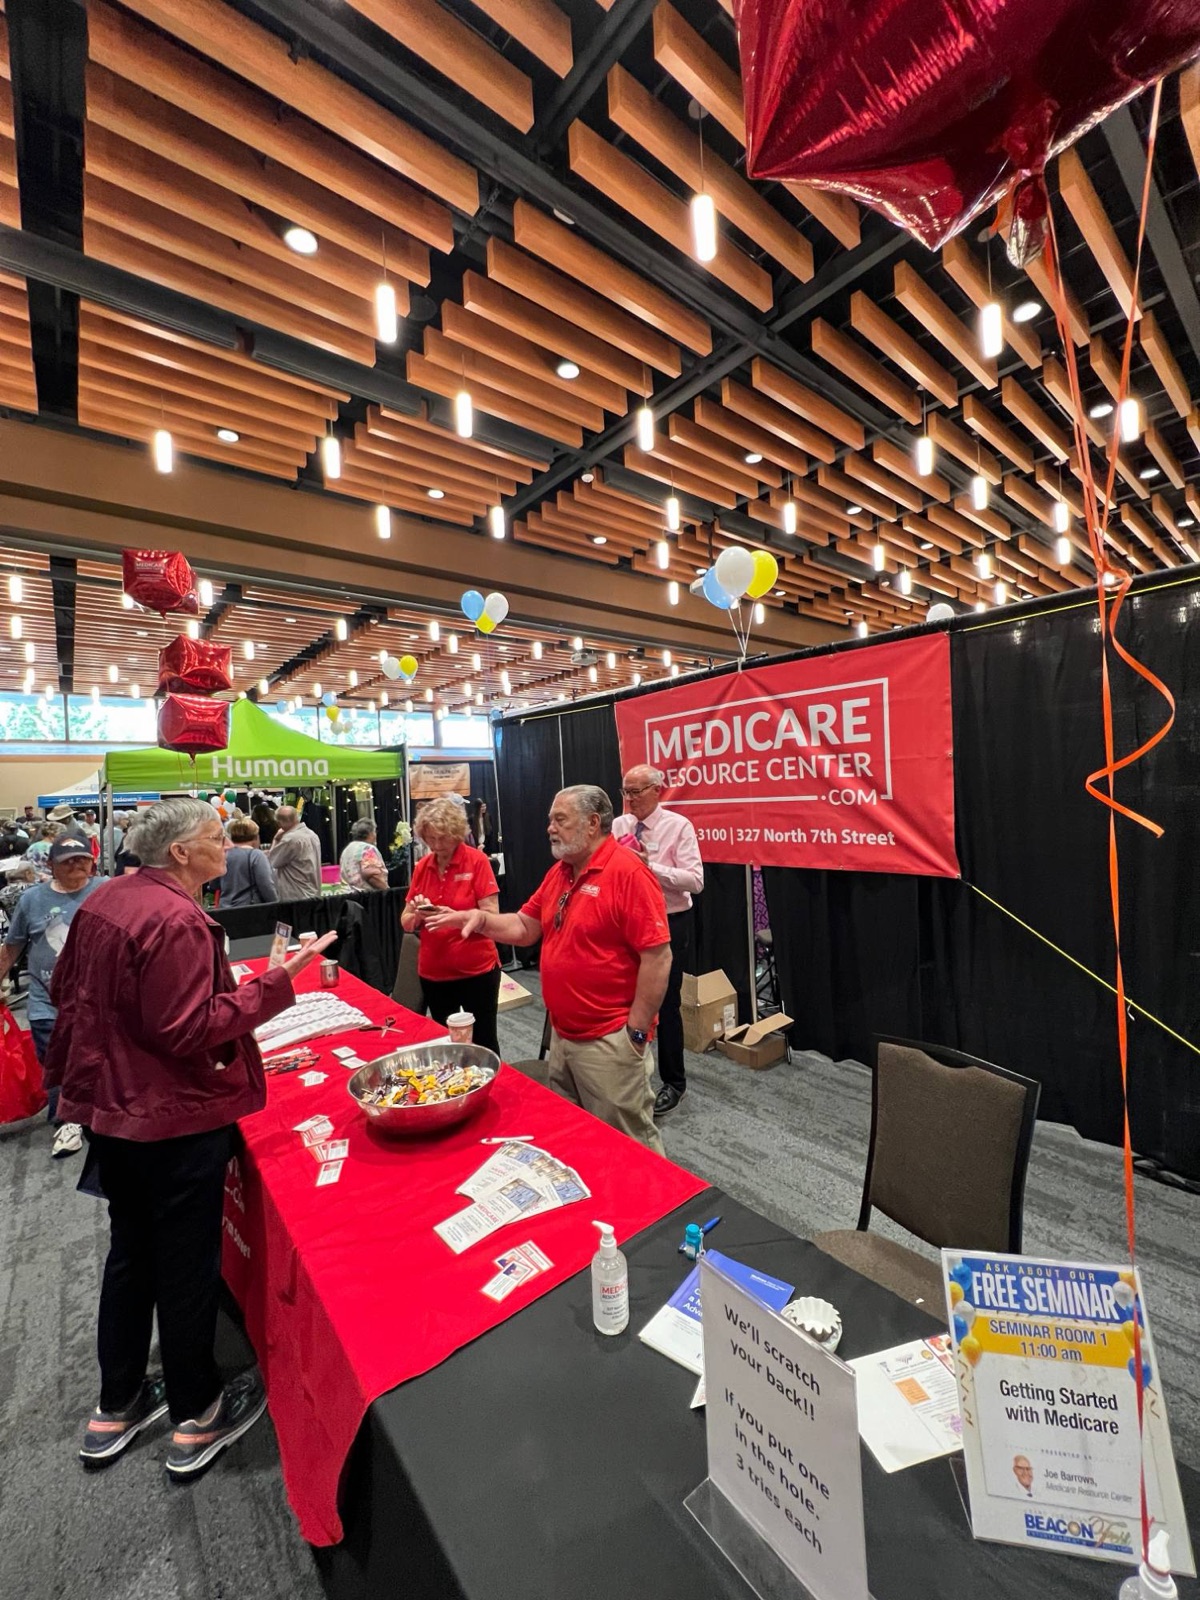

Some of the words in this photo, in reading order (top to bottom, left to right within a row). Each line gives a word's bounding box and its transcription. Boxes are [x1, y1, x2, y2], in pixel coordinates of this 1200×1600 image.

[653, 697, 871, 763] MEDICARE
[212, 755, 329, 778] Humana
[657, 761, 760, 788] RESOURCE
[766, 752, 874, 781] CENTER
[821, 789, 877, 806] .COM
[737, 829, 760, 842] 327
[764, 826, 807, 843] North
[810, 827, 837, 844] 7th
[841, 829, 896, 846] Street
[986, 1263, 1010, 1274] ASK
[1018, 1266, 1060, 1278] ABOUT
[1070, 1271, 1096, 1282] OUR
[683, 1302, 703, 1318] Adva
[972, 1271, 1020, 1310] FREE
[1021, 1276, 1120, 1321] SEMINAR
[990, 1319, 1051, 1339] SEMINAR
[1055, 1327, 1097, 1345] ROOM
[1101, 1333, 1107, 1346] 1
[725, 1304, 759, 1345] We'll
[764, 1340, 820, 1396] scratch
[1021, 1342, 1057, 1359] 11:00
[1061, 1348, 1082, 1361] am
[731, 1339, 762, 1374] your
[766, 1366, 815, 1421] back!!
[1000, 1379, 1055, 1406] Getting
[1059, 1387, 1118, 1411] Started
[1005, 1405, 1040, 1424] with
[1044, 1408, 1119, 1435] Medicare
[725, 1387, 735, 1406] If
[738, 1403, 763, 1435] you
[768, 1432, 794, 1466] put
[799, 1463, 829, 1500] one
[735, 1423, 747, 1447] in
[751, 1441, 775, 1475] the
[780, 1468, 820, 1521] hole.
[1044, 1469, 1058, 1479] Joe
[1060, 1470, 1098, 1487] Barrows,
[736, 1453, 744, 1471] 3
[748, 1466, 781, 1509] tries
[785, 1508, 822, 1554] each
[1046, 1481, 1077, 1494] Medicare
[1078, 1486, 1109, 1499] Resource
[1111, 1491, 1133, 1503] Center
[1024, 1513, 1094, 1539] BEACON
